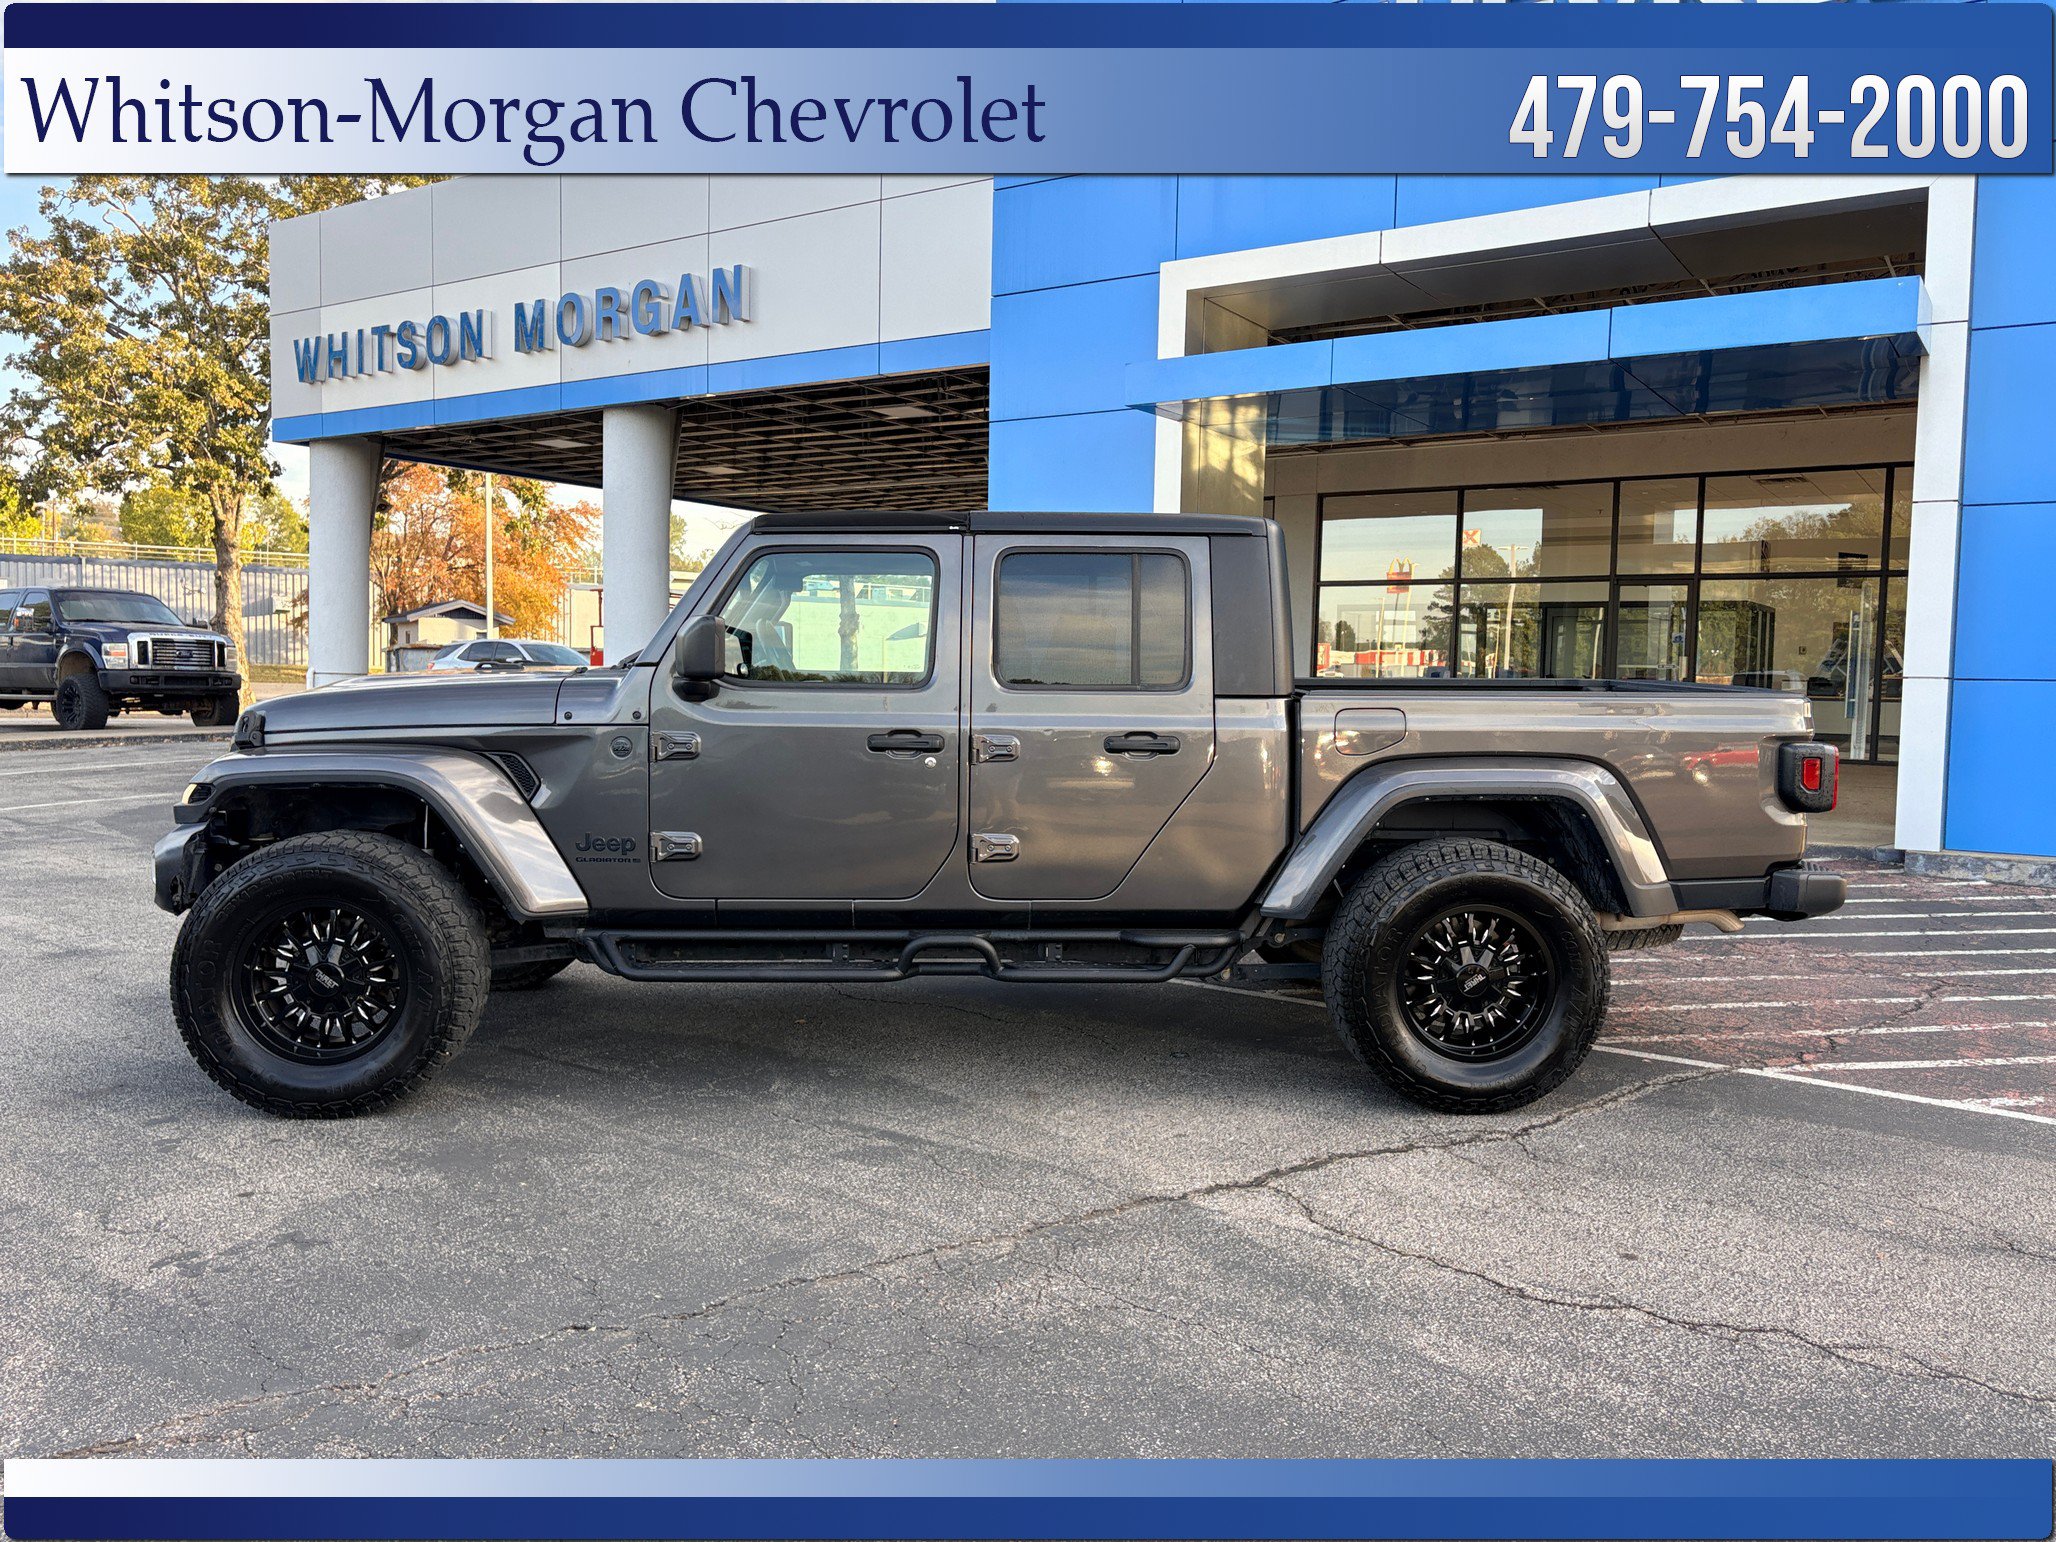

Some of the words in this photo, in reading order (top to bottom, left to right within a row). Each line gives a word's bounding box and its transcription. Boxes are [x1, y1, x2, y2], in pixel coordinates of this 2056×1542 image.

[294, 309, 493, 384] WHITSON
[514, 264, 751, 354] MORGAN
[577, 832, 636, 855] Jeep
